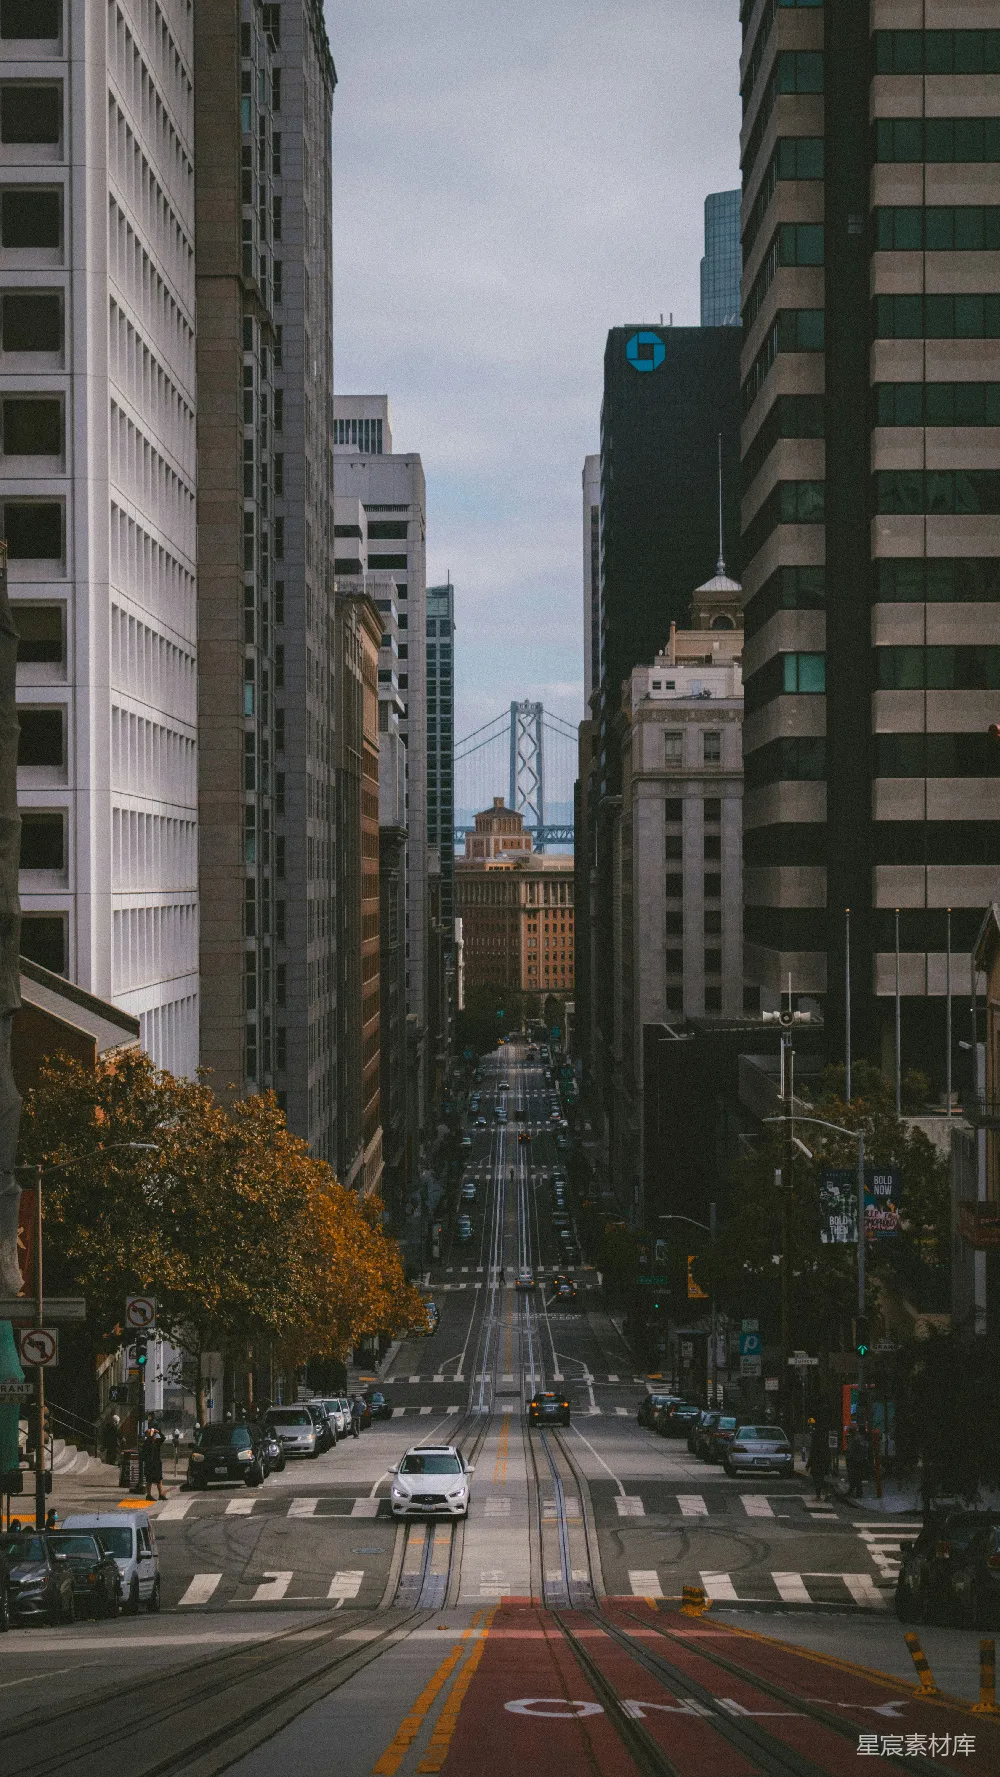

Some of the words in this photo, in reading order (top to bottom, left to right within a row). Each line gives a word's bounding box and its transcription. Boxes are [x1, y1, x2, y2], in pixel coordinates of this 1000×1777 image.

[873, 1175, 893, 1185] BOLD
[873, 1185, 893, 1195] NOW
[829, 1215, 848, 1225] BOLD
[829, 1225, 849, 1235] THEN
[503, 1697, 911, 1719] ONLY
